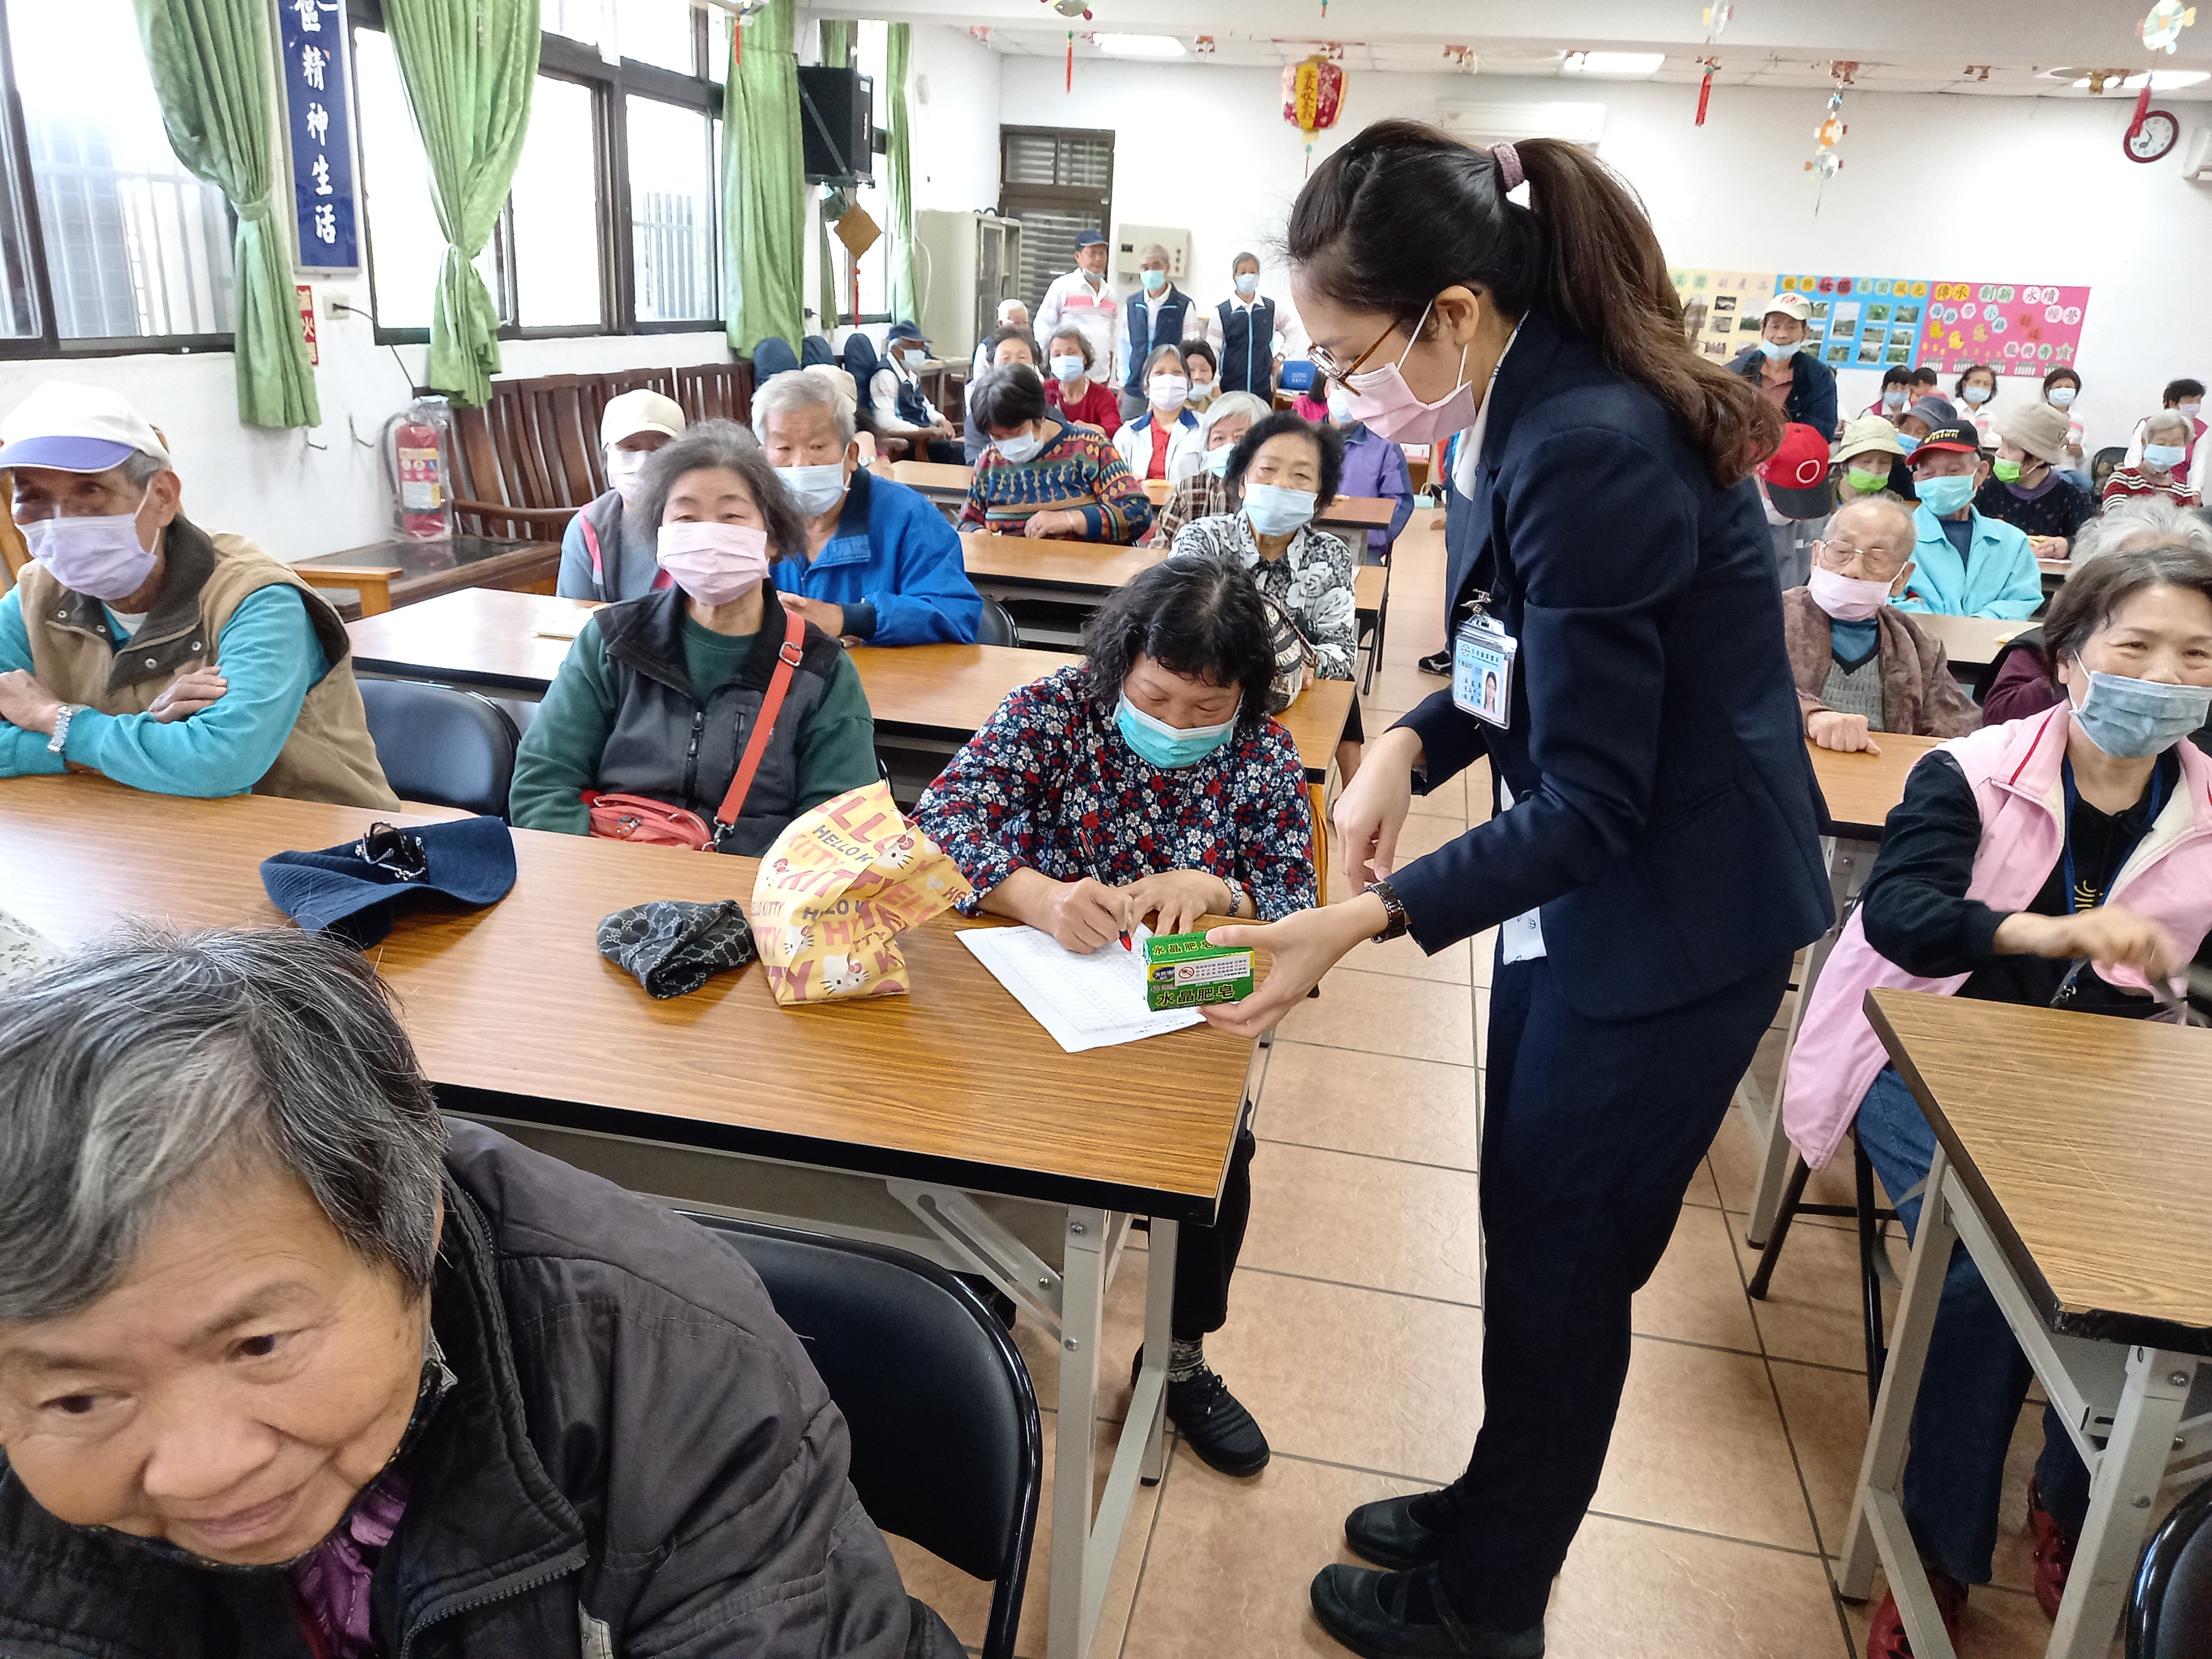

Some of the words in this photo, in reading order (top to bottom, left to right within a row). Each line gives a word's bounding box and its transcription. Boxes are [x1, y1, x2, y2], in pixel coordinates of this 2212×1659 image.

[812, 824, 860, 856] HELLO
[1153, 940, 1215, 956] 水晶肥皂
[1156, 984, 1235, 1006] 水晶肥皂
